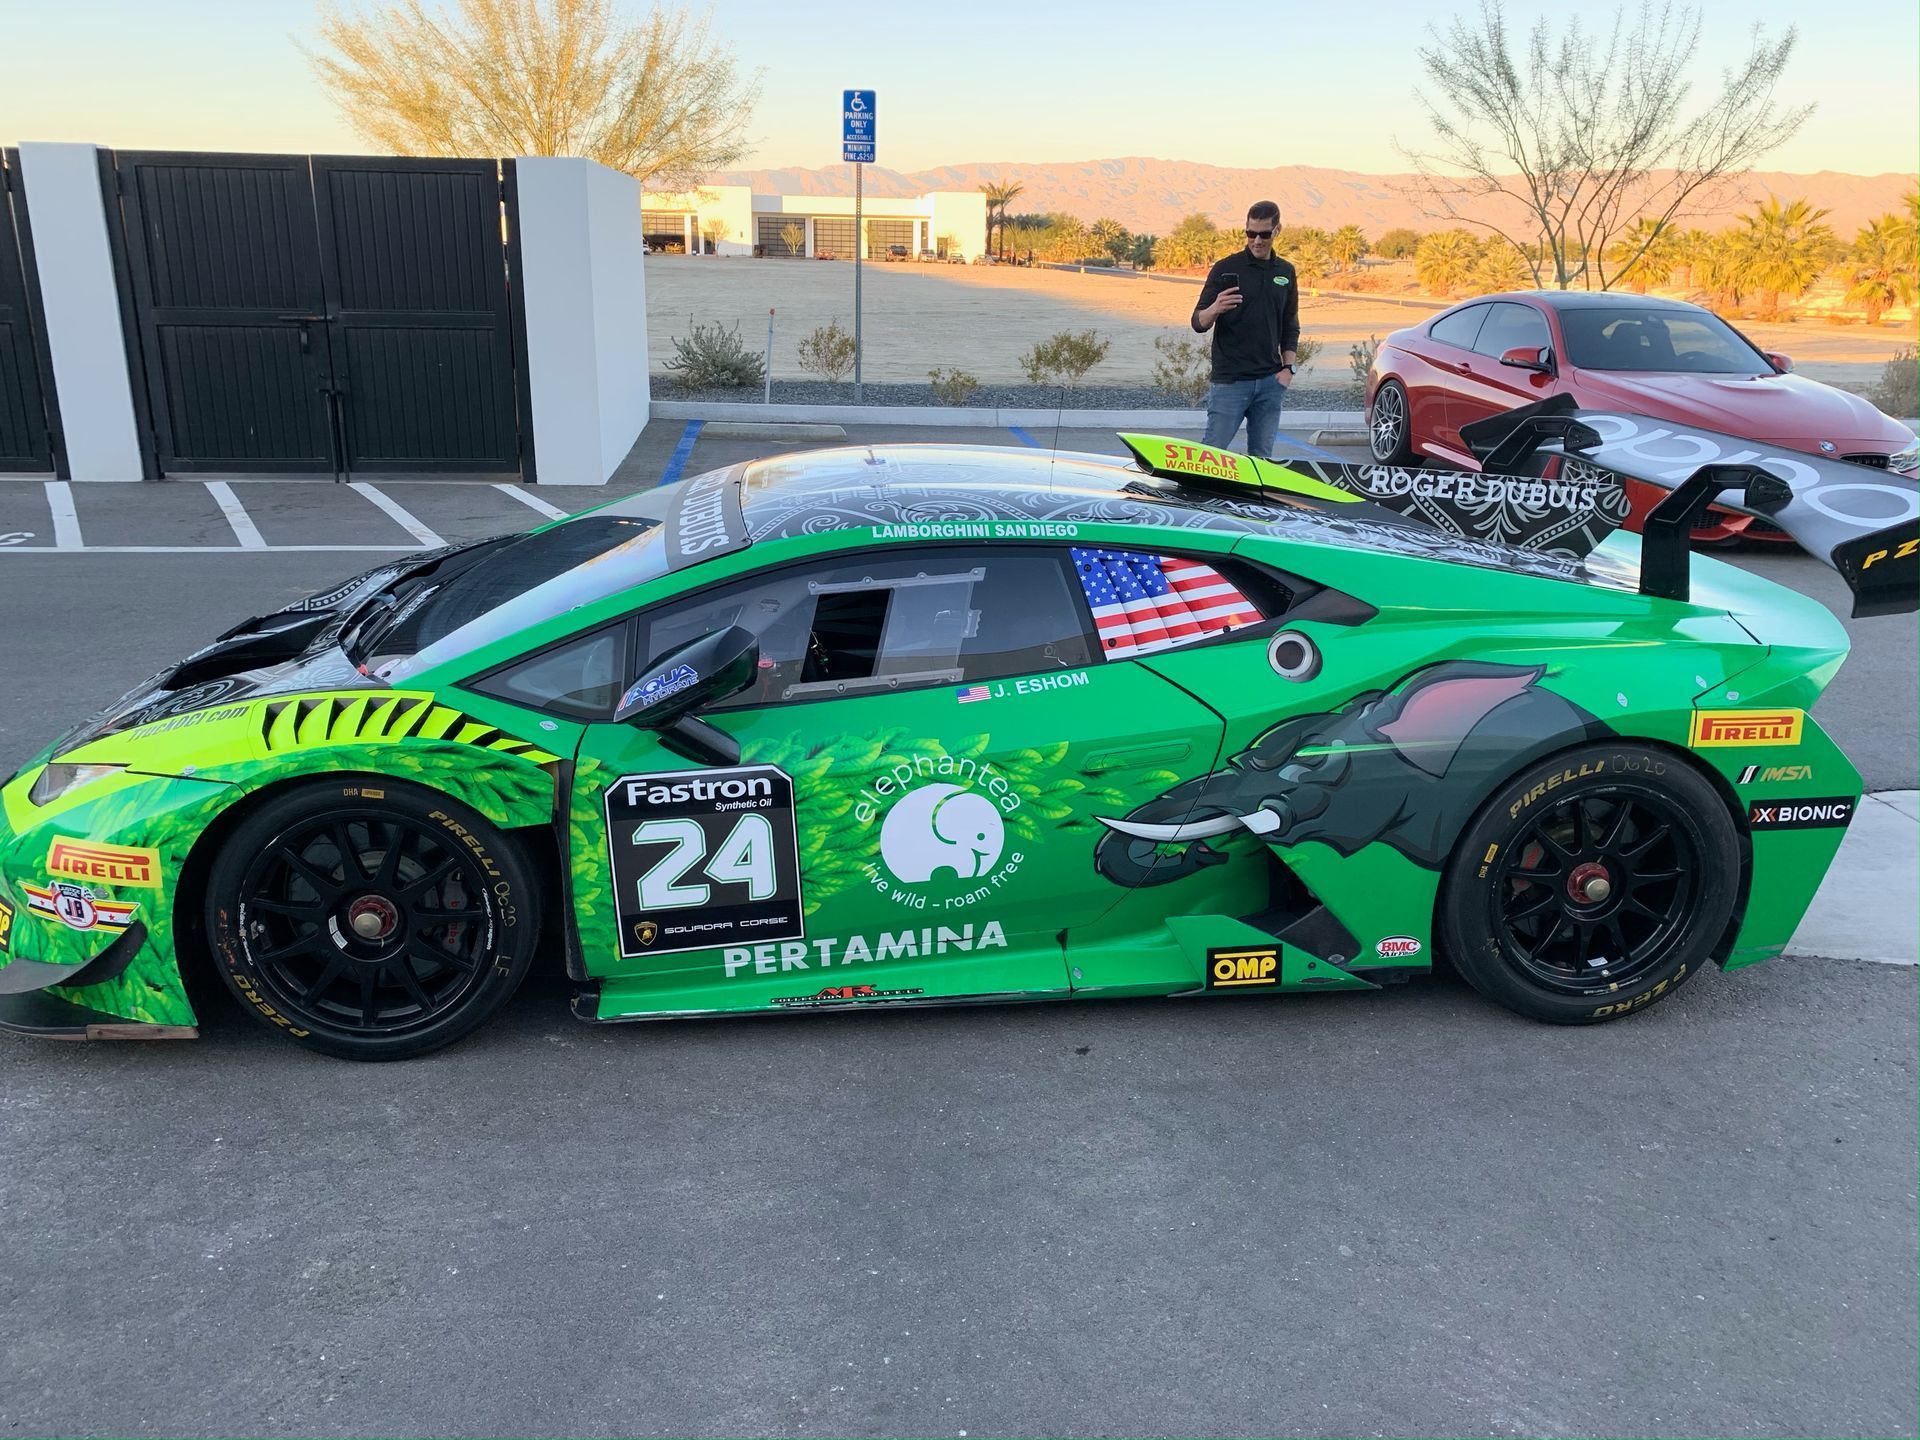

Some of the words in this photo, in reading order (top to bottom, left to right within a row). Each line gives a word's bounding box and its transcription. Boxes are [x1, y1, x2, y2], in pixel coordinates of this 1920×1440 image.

[845, 111, 874, 120] PARKING
[850, 120, 868, 128] ONLY
[844, 152, 857, 160] FINE
[858, 152, 874, 161] $250
[847, 144, 871, 152] MINIMUM
[1164, 444, 1238, 471] STAR
[1165, 460, 1240, 480] WAREHOUSE
[1368, 470, 1476, 500] ROGER
[1484, 479, 1598, 511] DUBUIS
[872, 523, 990, 538] LAMBORGHINI
[994, 524, 1027, 538] SAN
[1029, 524, 1079, 537] DIEGO
[625, 663, 698, 708] AQUA
[994, 683, 1012, 698] J.
[1015, 671, 1090, 695] ESHOM
[1701, 716, 1794, 741] PIRELLI
[1759, 765, 1813, 783] IMSA
[343, 786, 358, 797] DHA
[626, 777, 772, 806] Fastron
[854, 753, 1021, 823] elephantea
[1509, 760, 1605, 820] PIRELLI
[715, 799, 758, 812] Synthetic
[759, 798, 772, 808] Oil
[428, 810, 501, 877] PIRELLI
[51, 843, 150, 882] PIRELLI
[632, 812, 778, 911] 24
[862, 862, 889, 893] live
[891, 888, 926, 909] wild
[945, 886, 991, 909] roam
[991, 852, 1025, 888] free
[664, 921, 733, 935] SQUADRA
[739, 916, 789, 927] CORSE
[723, 920, 1008, 978] PERTAMINA
[1380, 941, 1418, 952] BMC
[1213, 956, 1277, 980] OMP
[232, 974, 292, 1028] ZERO
[289, 1027, 311, 1038] P
